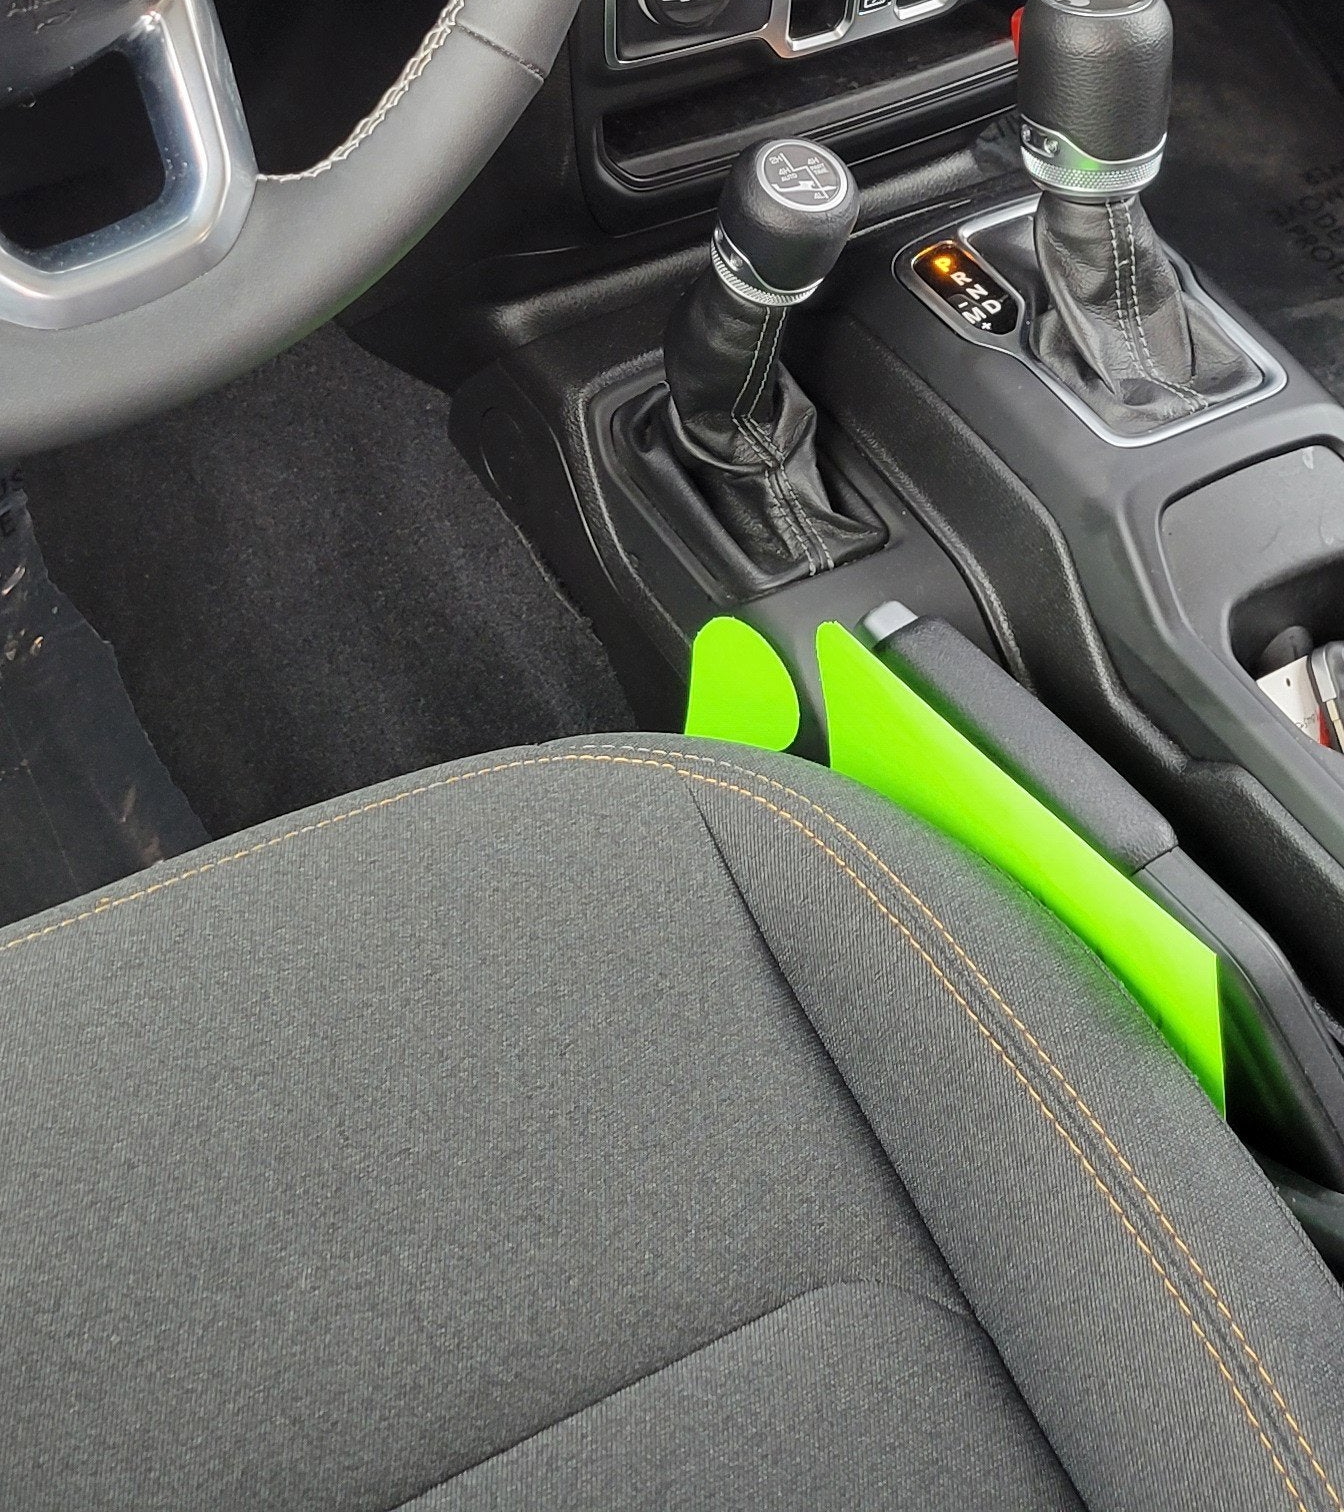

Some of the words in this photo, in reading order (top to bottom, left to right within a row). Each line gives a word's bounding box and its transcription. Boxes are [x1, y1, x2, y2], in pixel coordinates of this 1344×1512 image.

[934, 257, 952, 273] P
[950, 271, 973, 286] R
[965, 283, 989, 300] N
[981, 299, 1002, 315] D
[961, 306, 988, 325] M
